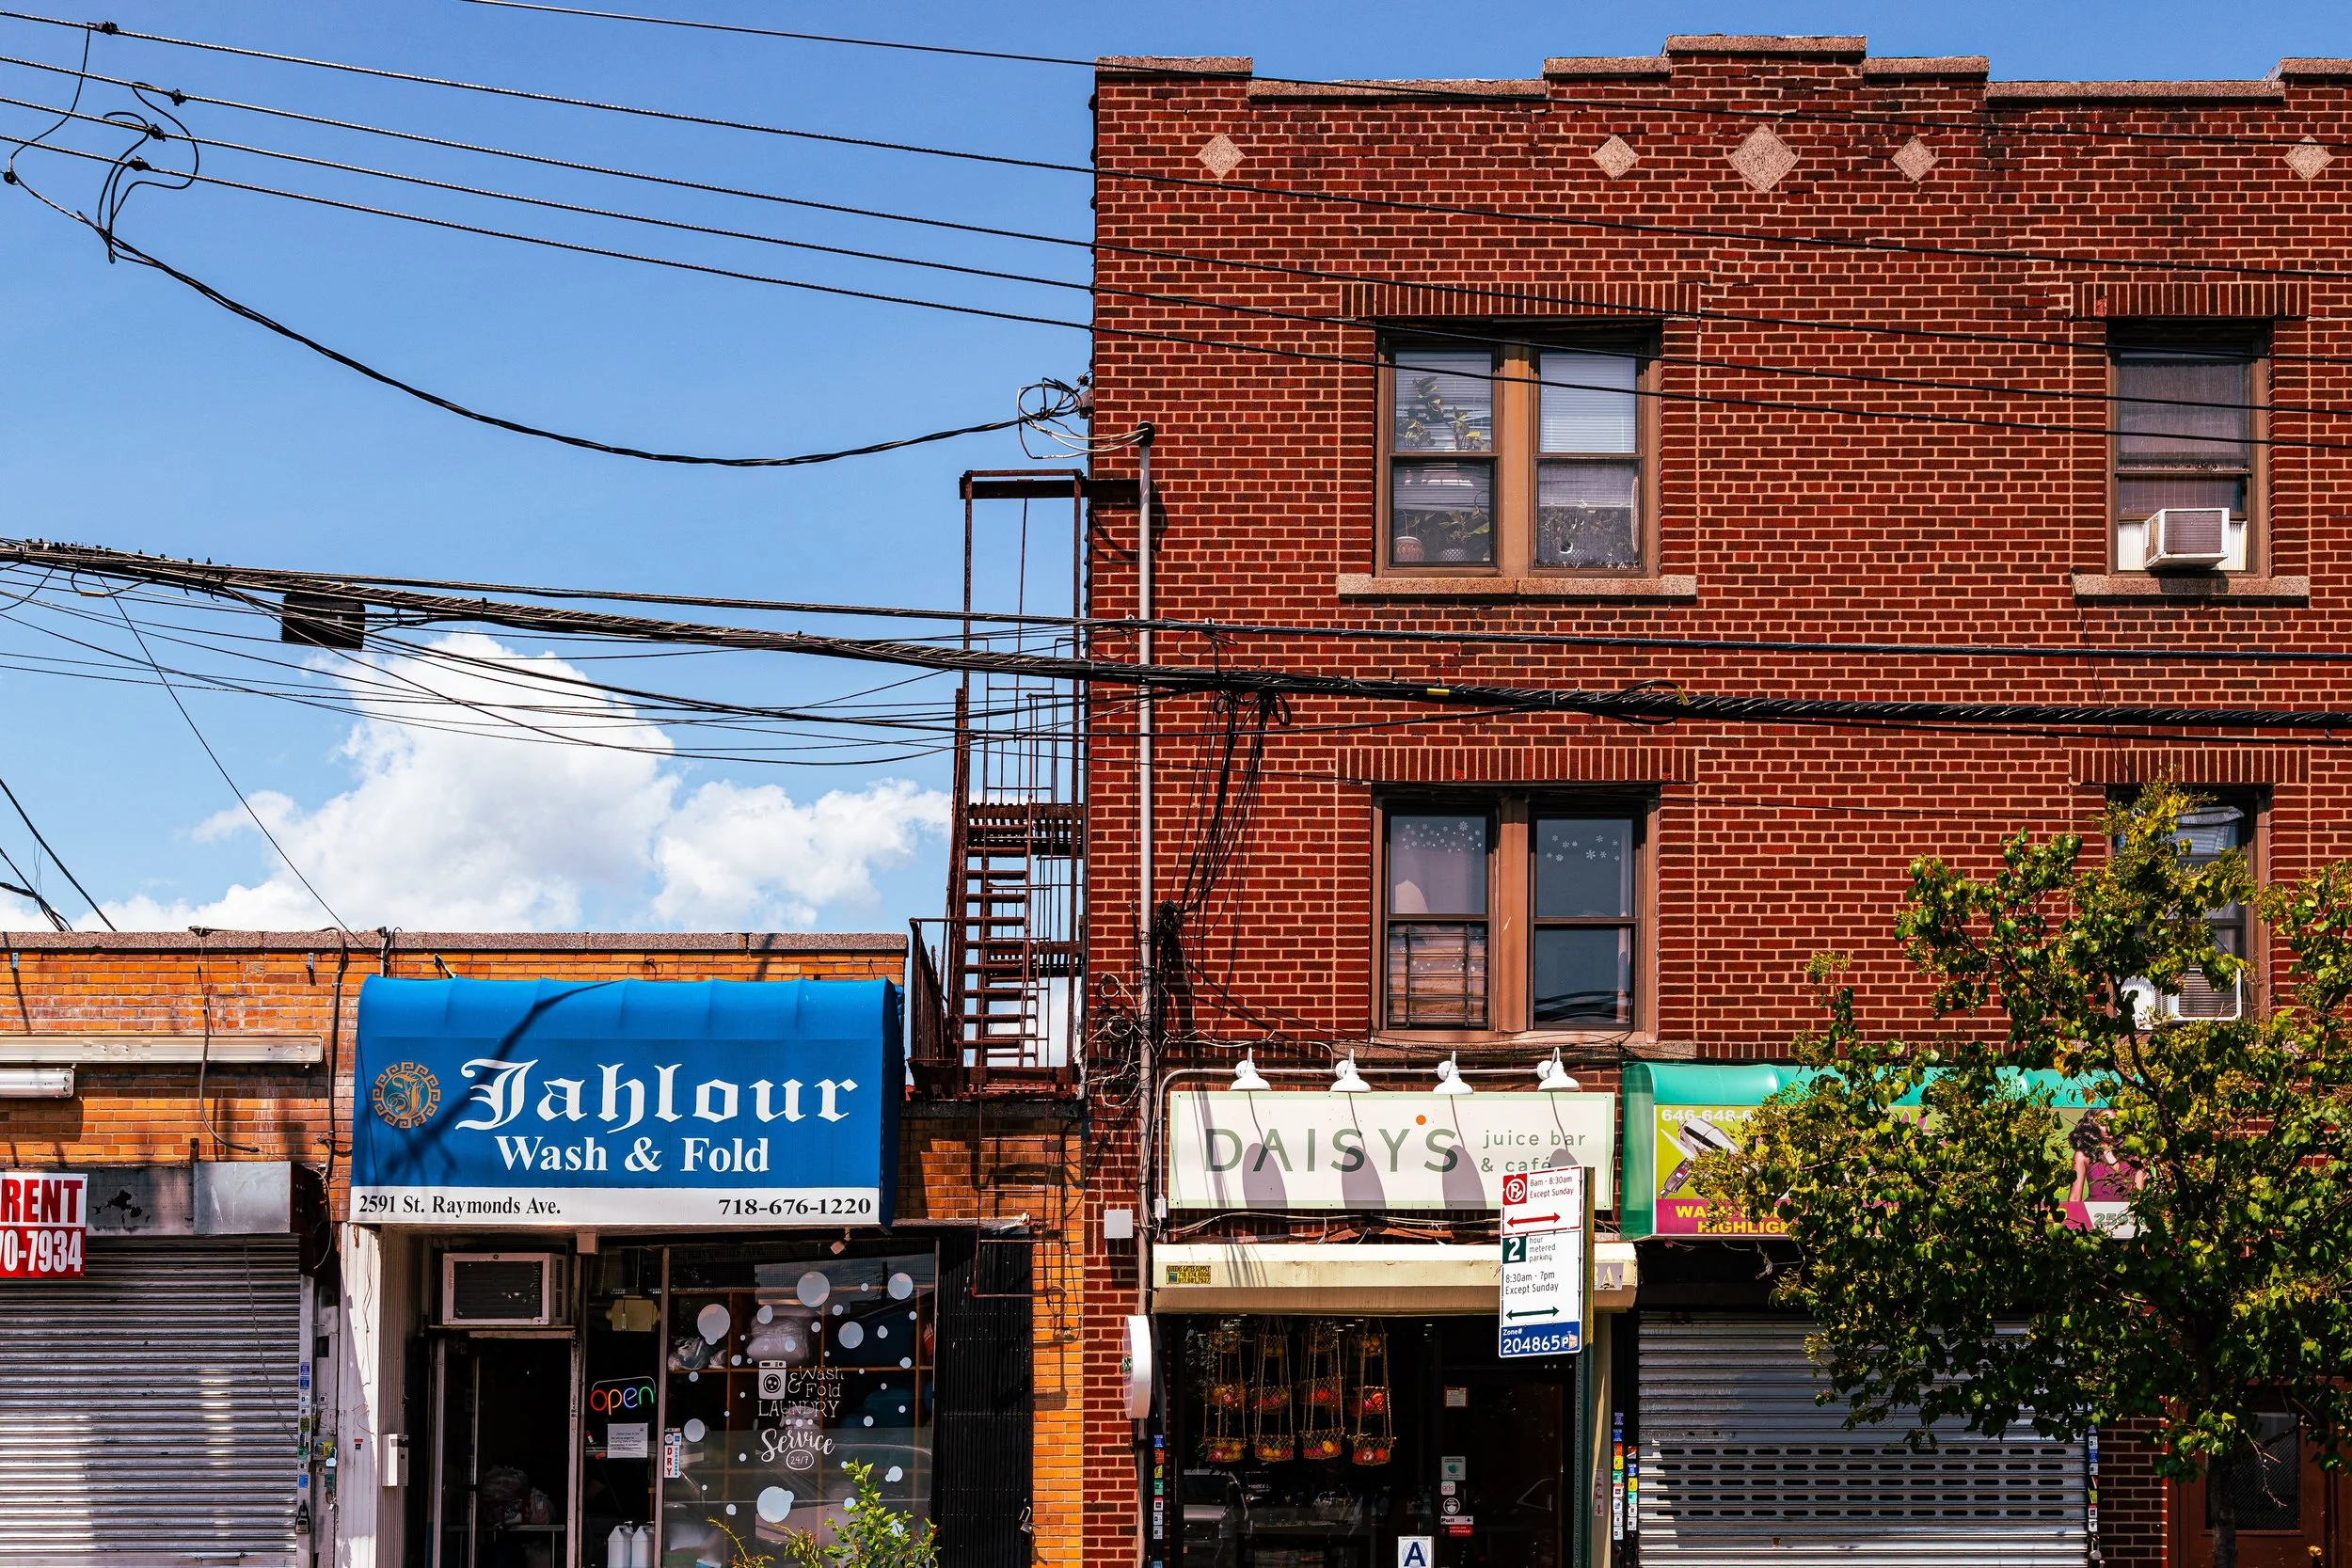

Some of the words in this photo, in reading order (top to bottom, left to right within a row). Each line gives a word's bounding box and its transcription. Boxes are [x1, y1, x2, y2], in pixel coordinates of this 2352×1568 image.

[455, 1058, 859, 1133] Jahlour
[1483, 1130, 1539, 1148] juice
[1551, 1131, 1585, 1146] bar
[495, 1135, 609, 1172] Wash
[625, 1136, 662, 1172] &
[680, 1137, 770, 1173] Fold
[1481, 1157, 1493, 1172] &
[1505, 1156, 1551, 1172] café
[1530, 1179, 1543, 1187] 8am
[1549, 1176, 1572, 1185] 8:30am
[0, 1179, 83, 1223] RENT
[1530, 1189, 1550, 1199] Except
[1551, 1187, 1574, 1196] Sunday
[358, 1195, 396, 1212] 2591
[403, 1195, 425, 1213] St.
[432, 1196, 520, 1218] Raymonds
[526, 1196, 561, 1214] Ave.
[718, 1197, 871, 1215] 718-676-1220
[1508, 1237, 1520, 1261] 2
[1529, 1243, 1556, 1253] metered
[1529, 1254, 1552, 1263] parking
[1505, 1272, 1533, 1283] 8:30am
[1540, 1271, 1555, 1281] 7pm
[1505, 1285, 1530, 1294] Except
[1532, 1282, 1559, 1292] Sunday
[1502, 1327, 1523, 1336] Zone#
[1502, 1335, 1561, 1354] 204865
[799, 1365, 845, 1380] Wash
[805, 1383, 841, 1398] Fold
[590, 1386, 654, 1416] open
[757, 1400, 839, 1418] LAUNDRY
[761, 1428, 835, 1463] Service
[790, 1455, 809, 1465] 24/7
[1403, 1541, 1426, 1567] A
